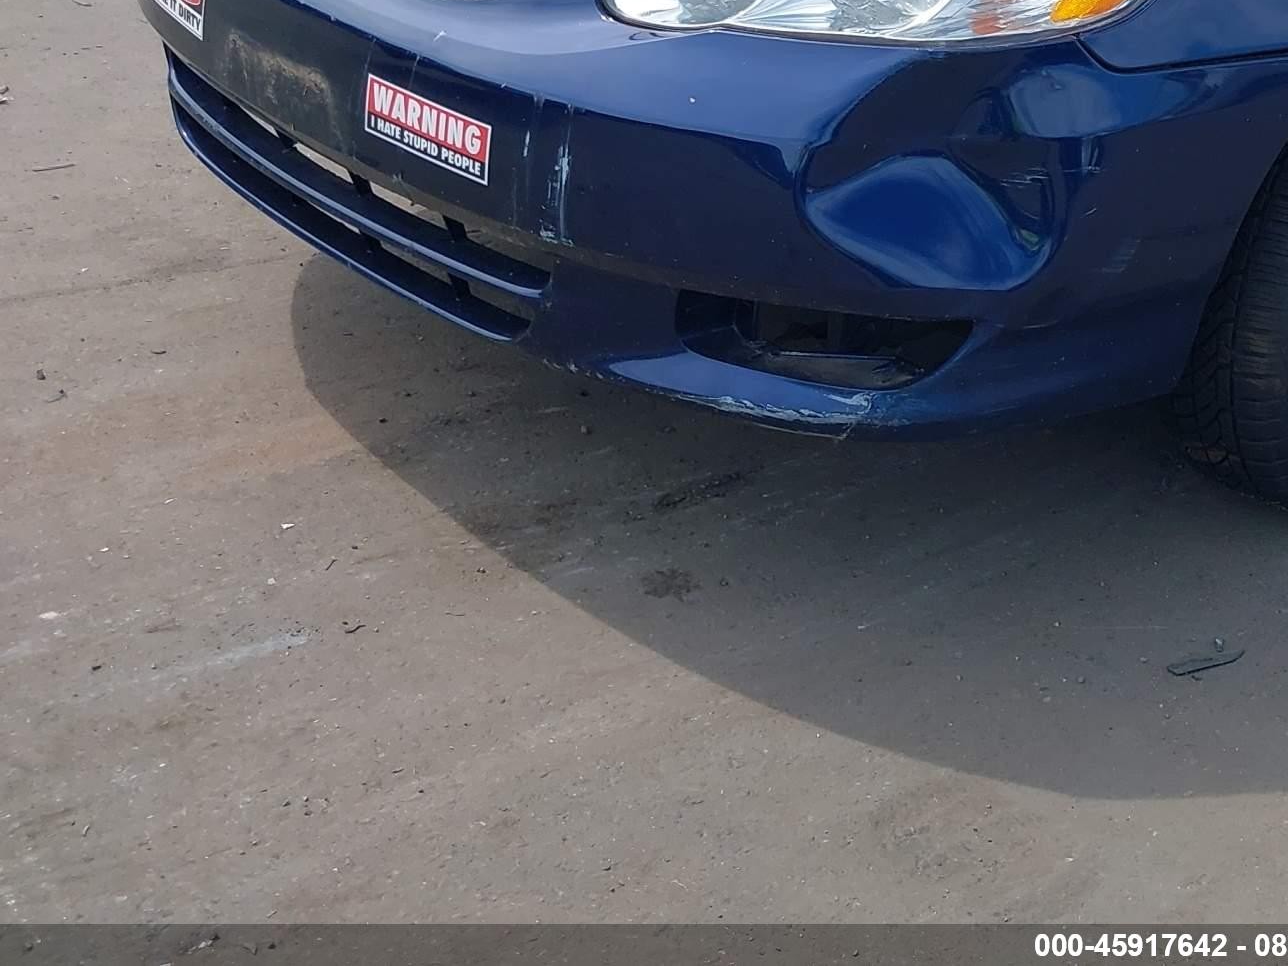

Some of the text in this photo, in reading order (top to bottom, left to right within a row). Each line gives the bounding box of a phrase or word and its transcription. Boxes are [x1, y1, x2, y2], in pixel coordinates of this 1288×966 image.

[178, 2, 201, 31] DIRTY
[370, 115, 482, 176] I HATE STUPID PEOPLE
[373, 82, 482, 155] WARNING
